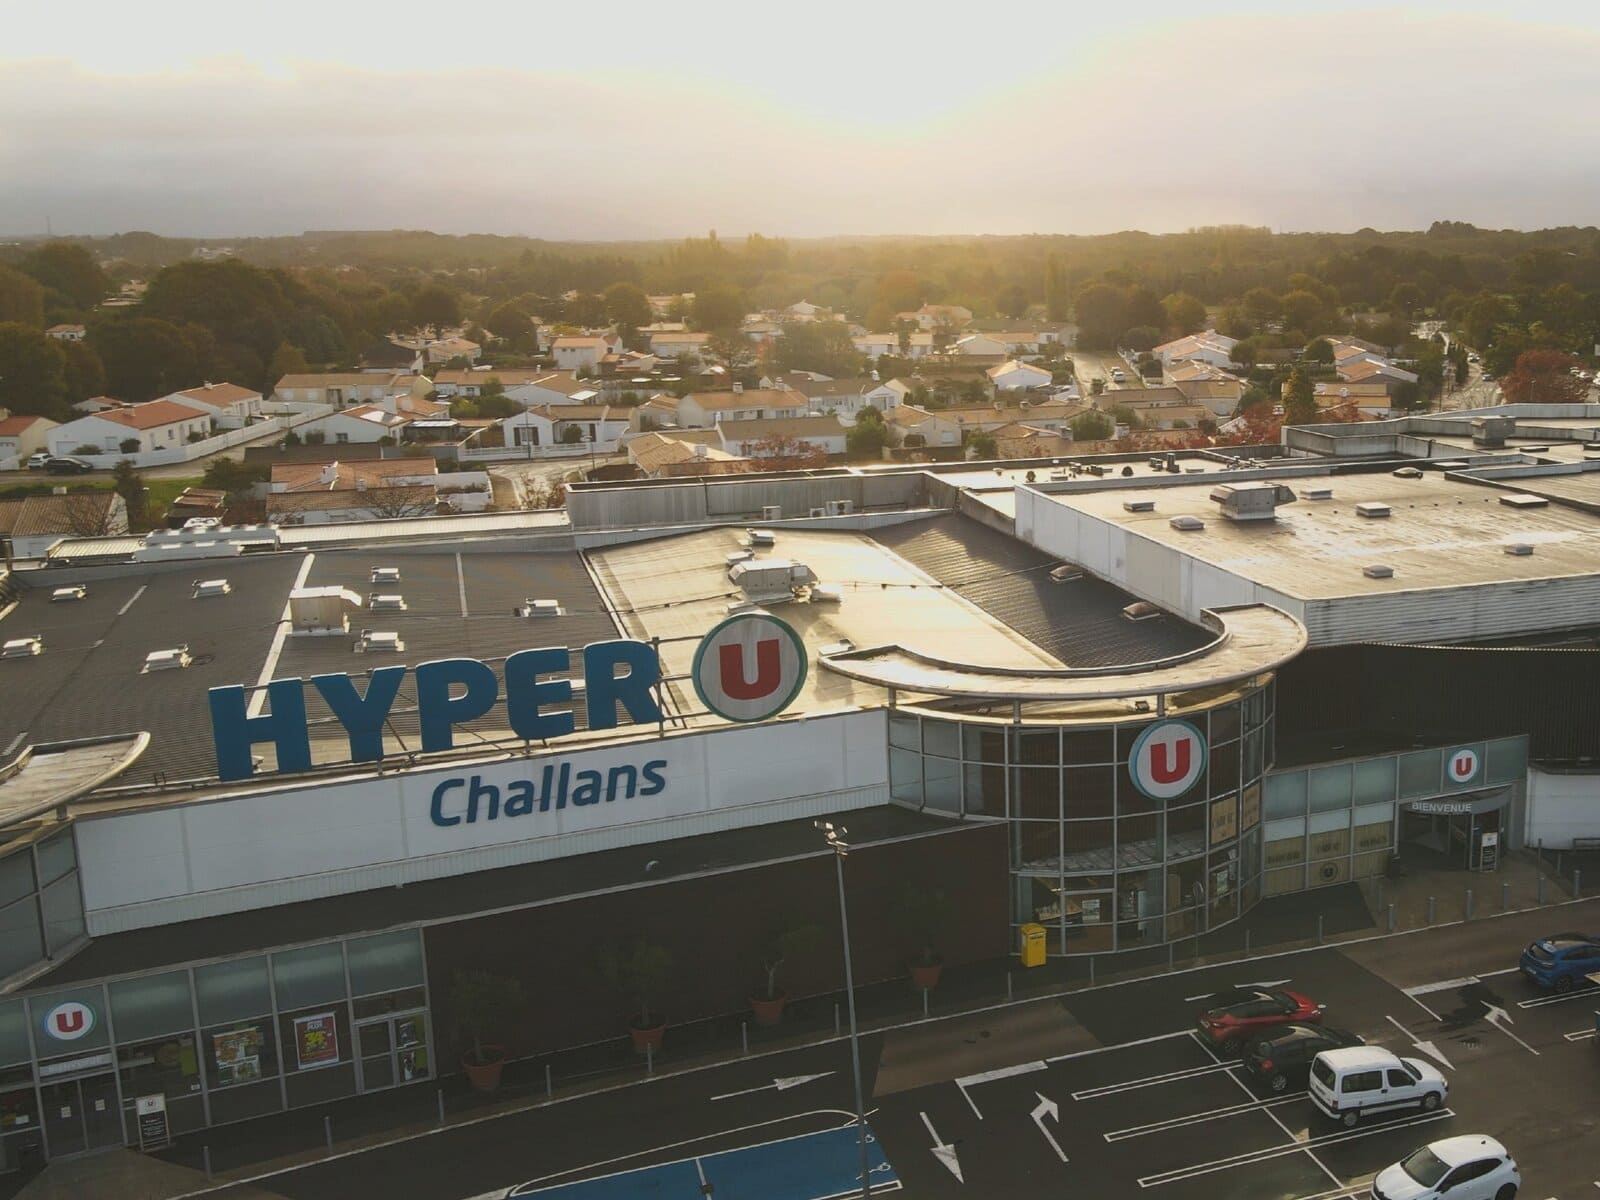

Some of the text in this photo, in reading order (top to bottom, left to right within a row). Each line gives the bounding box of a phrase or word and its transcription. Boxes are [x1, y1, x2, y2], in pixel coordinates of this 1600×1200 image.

[208, 638, 783, 782] HYPER U
[1150, 738, 1191, 785] U
[1456, 757, 1472, 777] U
[430, 759, 668, 827] Challans
[1411, 802, 1473, 813] BIENVENUE
[56, 1010, 84, 1033] U
